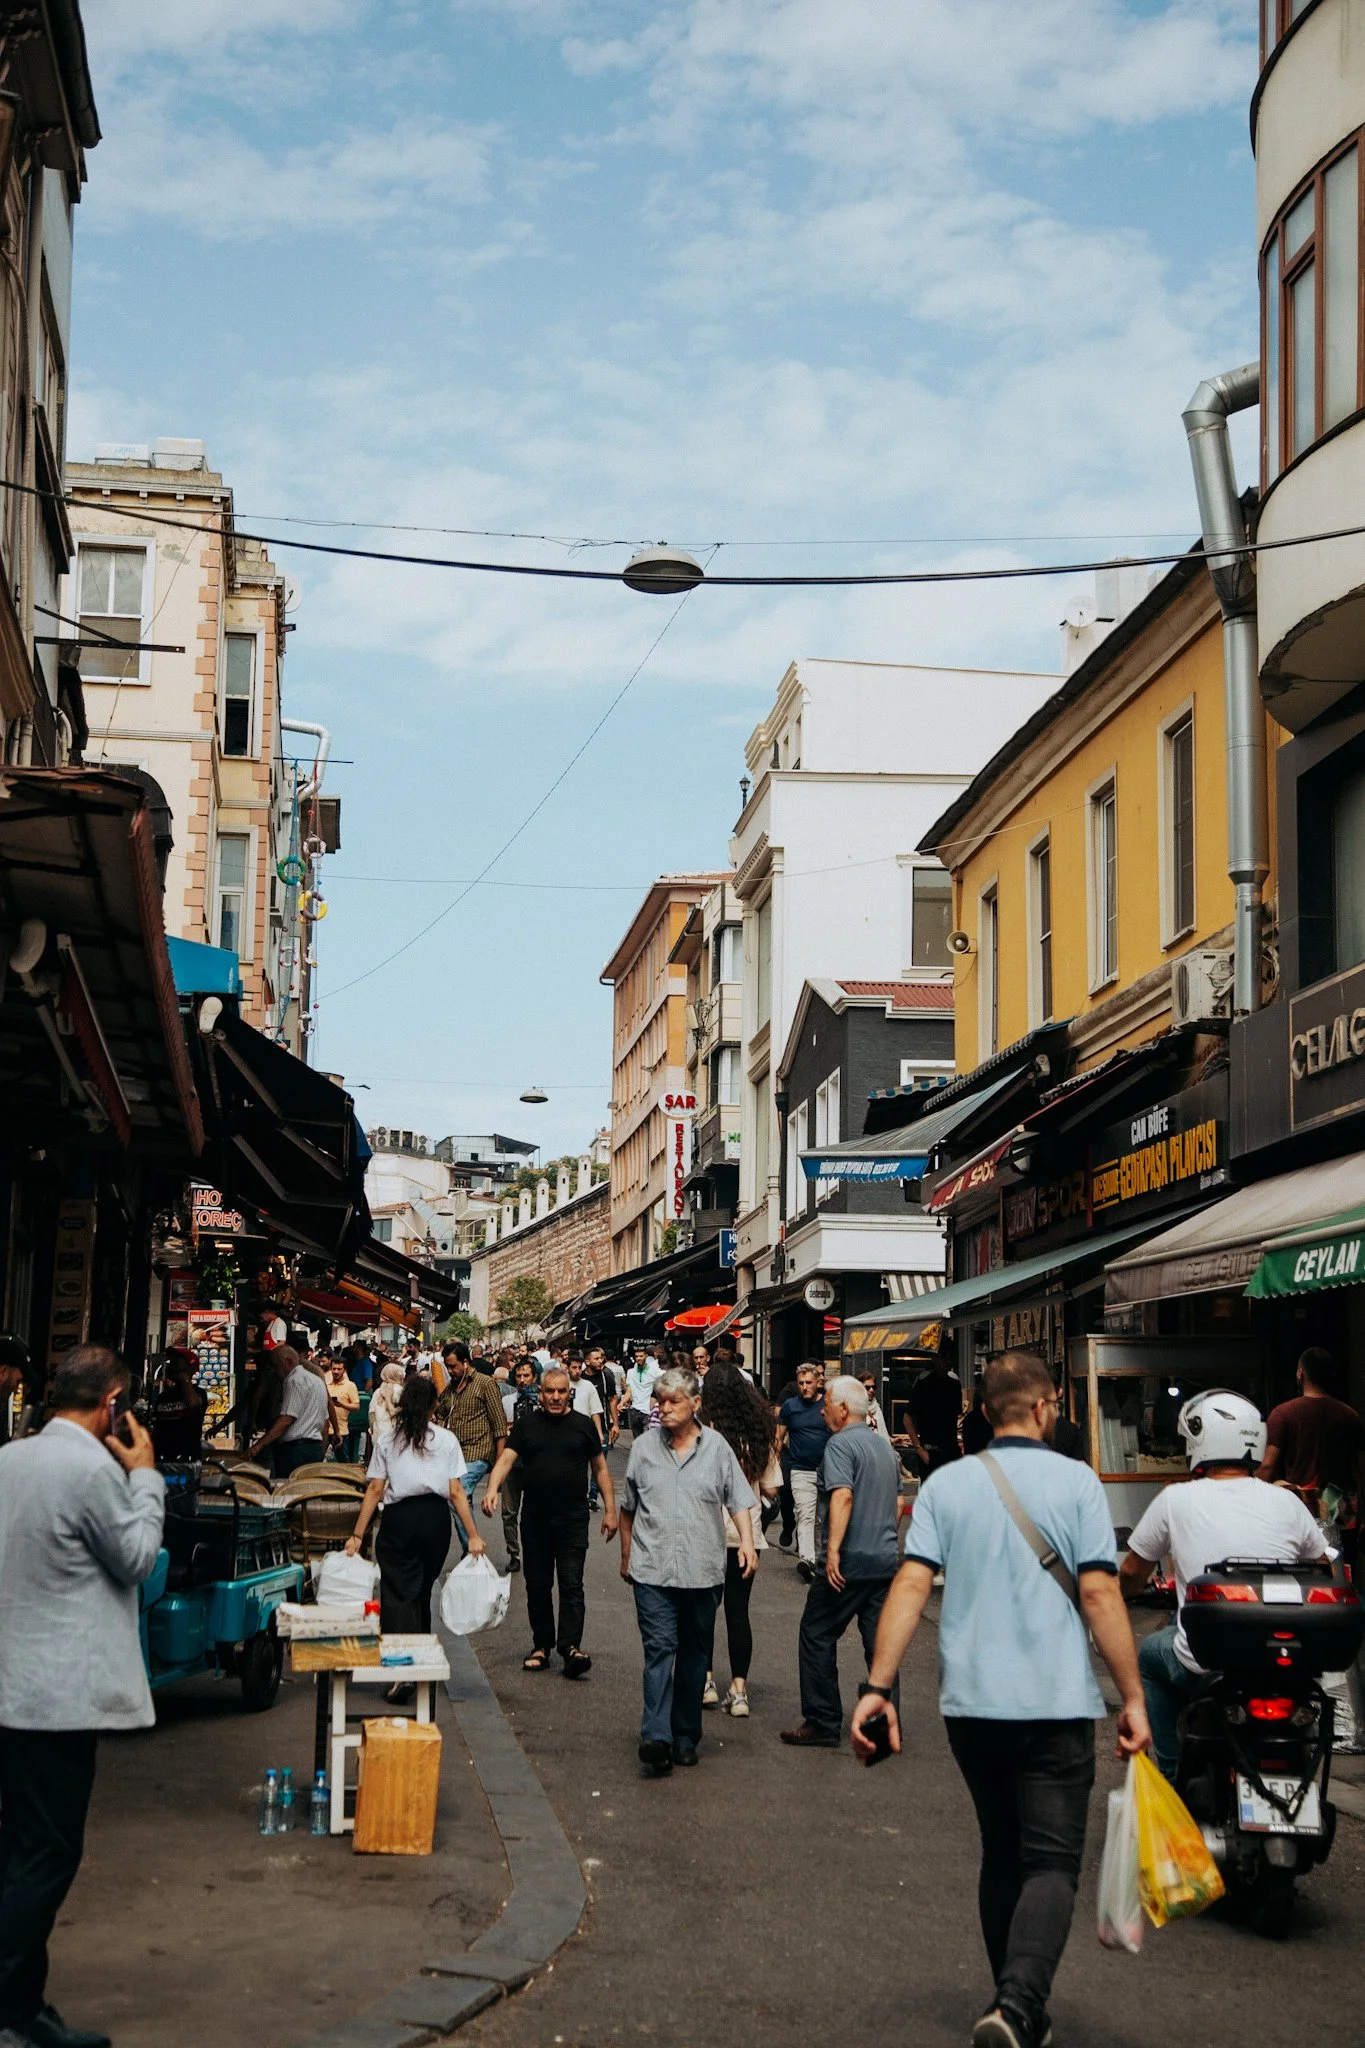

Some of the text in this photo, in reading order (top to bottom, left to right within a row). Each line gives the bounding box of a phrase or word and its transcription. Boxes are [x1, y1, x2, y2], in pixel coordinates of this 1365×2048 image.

[665, 1094, 696, 1111] ŞAR
[1147, 1105, 1168, 1138] BÜFE
[674, 1123, 685, 1217] RESTAURANT
[1293, 1239, 1360, 1283] CEYLAN
